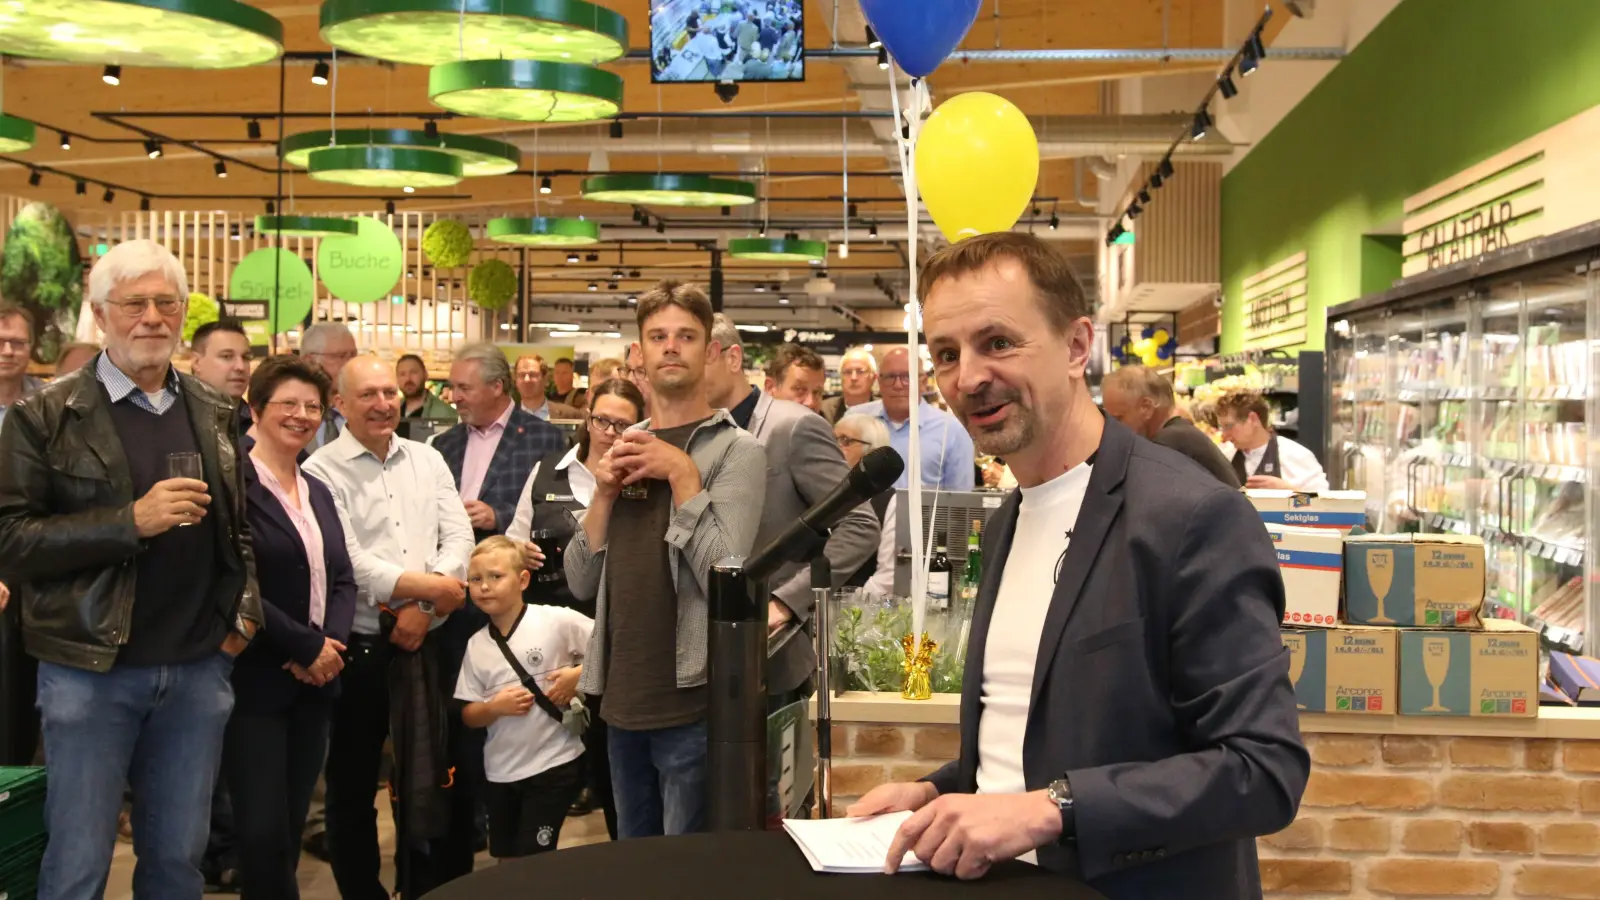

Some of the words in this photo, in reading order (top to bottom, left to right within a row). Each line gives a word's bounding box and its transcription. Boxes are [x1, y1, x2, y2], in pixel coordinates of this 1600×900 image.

[329, 251, 390, 270] Buche
[1284, 513, 1319, 523] Sektglas
[1432, 550, 1442, 560] 12
[1343, 635, 1354, 645] 12
[1336, 685, 1383, 696] Arcoroc
